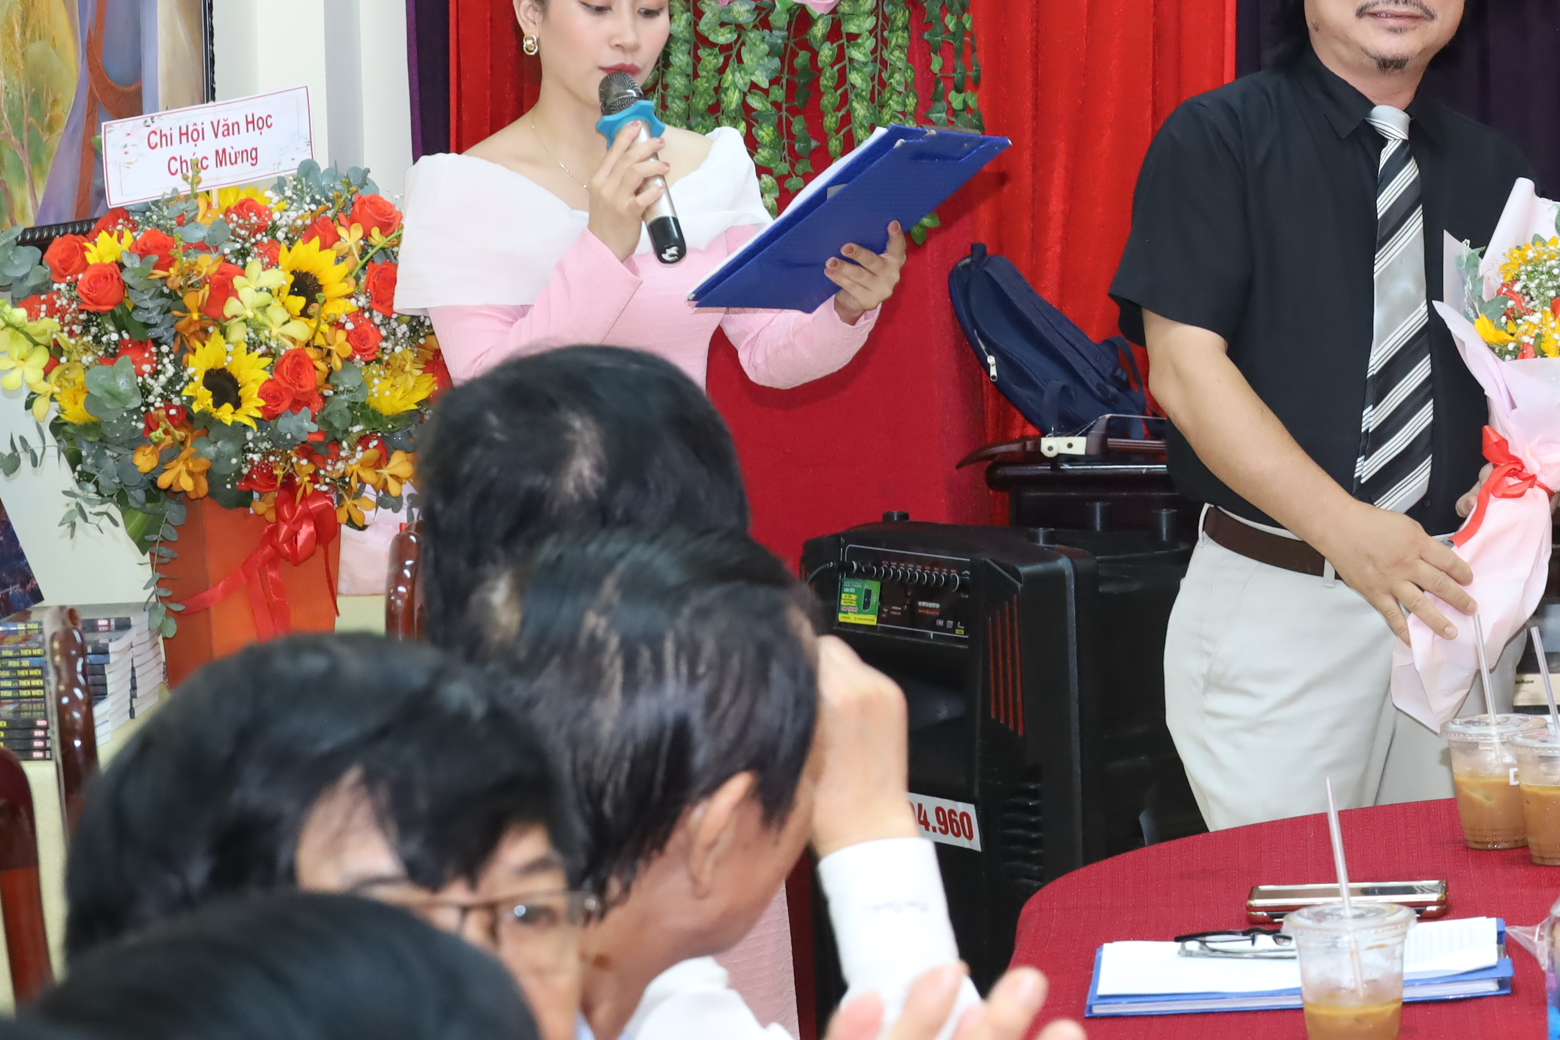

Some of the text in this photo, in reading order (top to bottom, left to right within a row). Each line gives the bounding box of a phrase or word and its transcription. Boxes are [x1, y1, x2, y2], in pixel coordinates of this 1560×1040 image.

[147, 112, 273, 150] Chi Hội Văn Học
[214, 145, 259, 168] Mừng
[909, 801, 974, 841] 4.960
